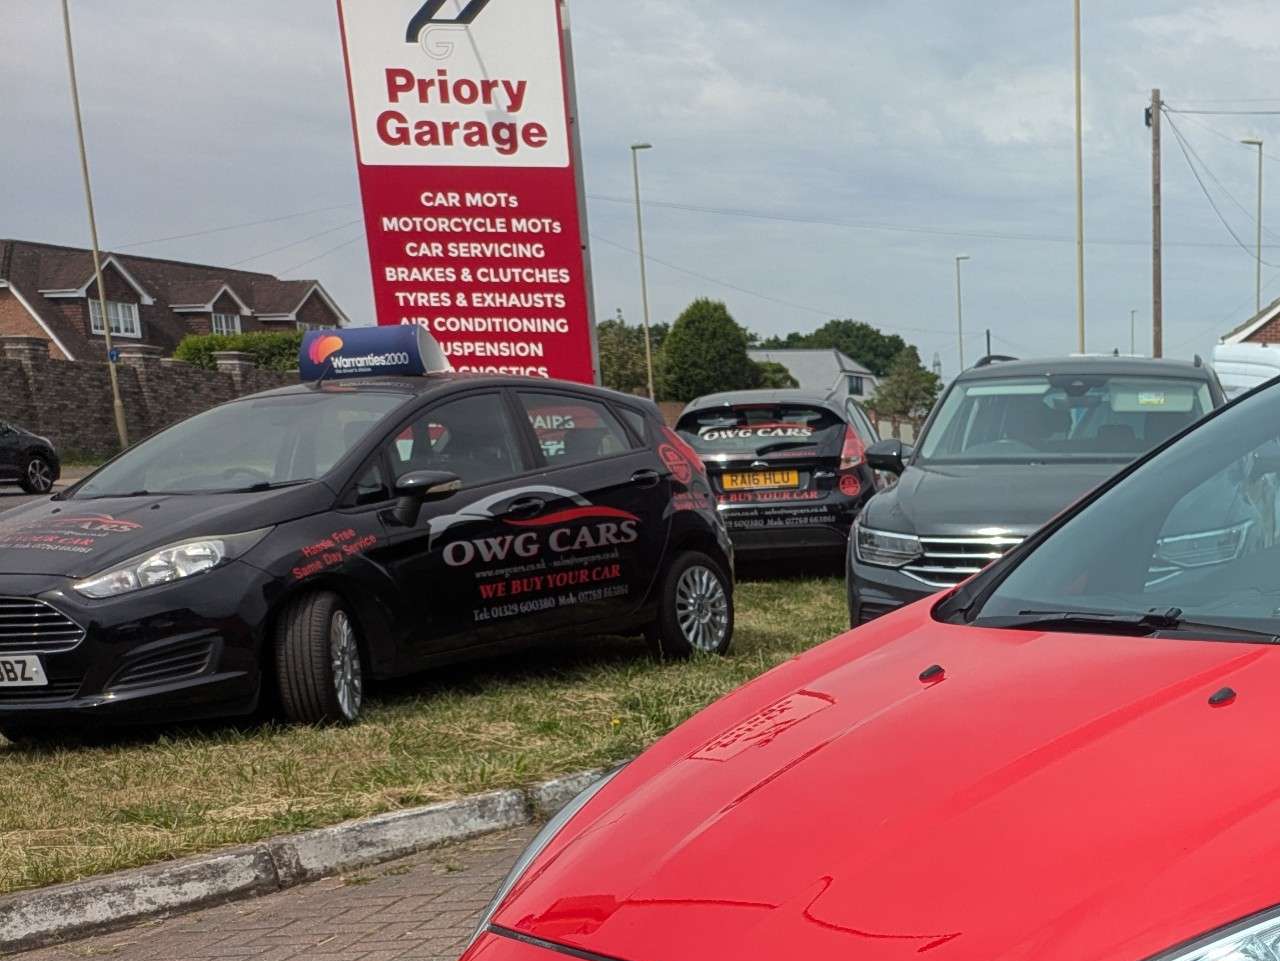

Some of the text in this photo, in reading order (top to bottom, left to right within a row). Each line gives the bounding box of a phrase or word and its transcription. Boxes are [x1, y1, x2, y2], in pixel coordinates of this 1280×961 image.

[385, 68, 527, 113] Priory
[376, 111, 547, 155] Garage
[420, 192, 518, 208] CAR MOTs
[383, 217, 561, 234] MOTORCYCLE MOTs
[405, 243, 545, 259] CAR SERVICING
[385, 268, 570, 284] BRAKES & CLUTCHES
[395, 292, 566, 308] TYRES & EXHAUSTS
[433, 317, 569, 333] CONDITIONING
[440, 342, 543, 357] USPENSION
[331, 352, 409, 368] Warranties2000
[703, 427, 813, 441] OWG CARS
[730, 471, 790, 486] RA16 HLU
[442, 520, 639, 566] OWG CARS
[480, 564, 621, 599] WE BUY YOUR CAR
